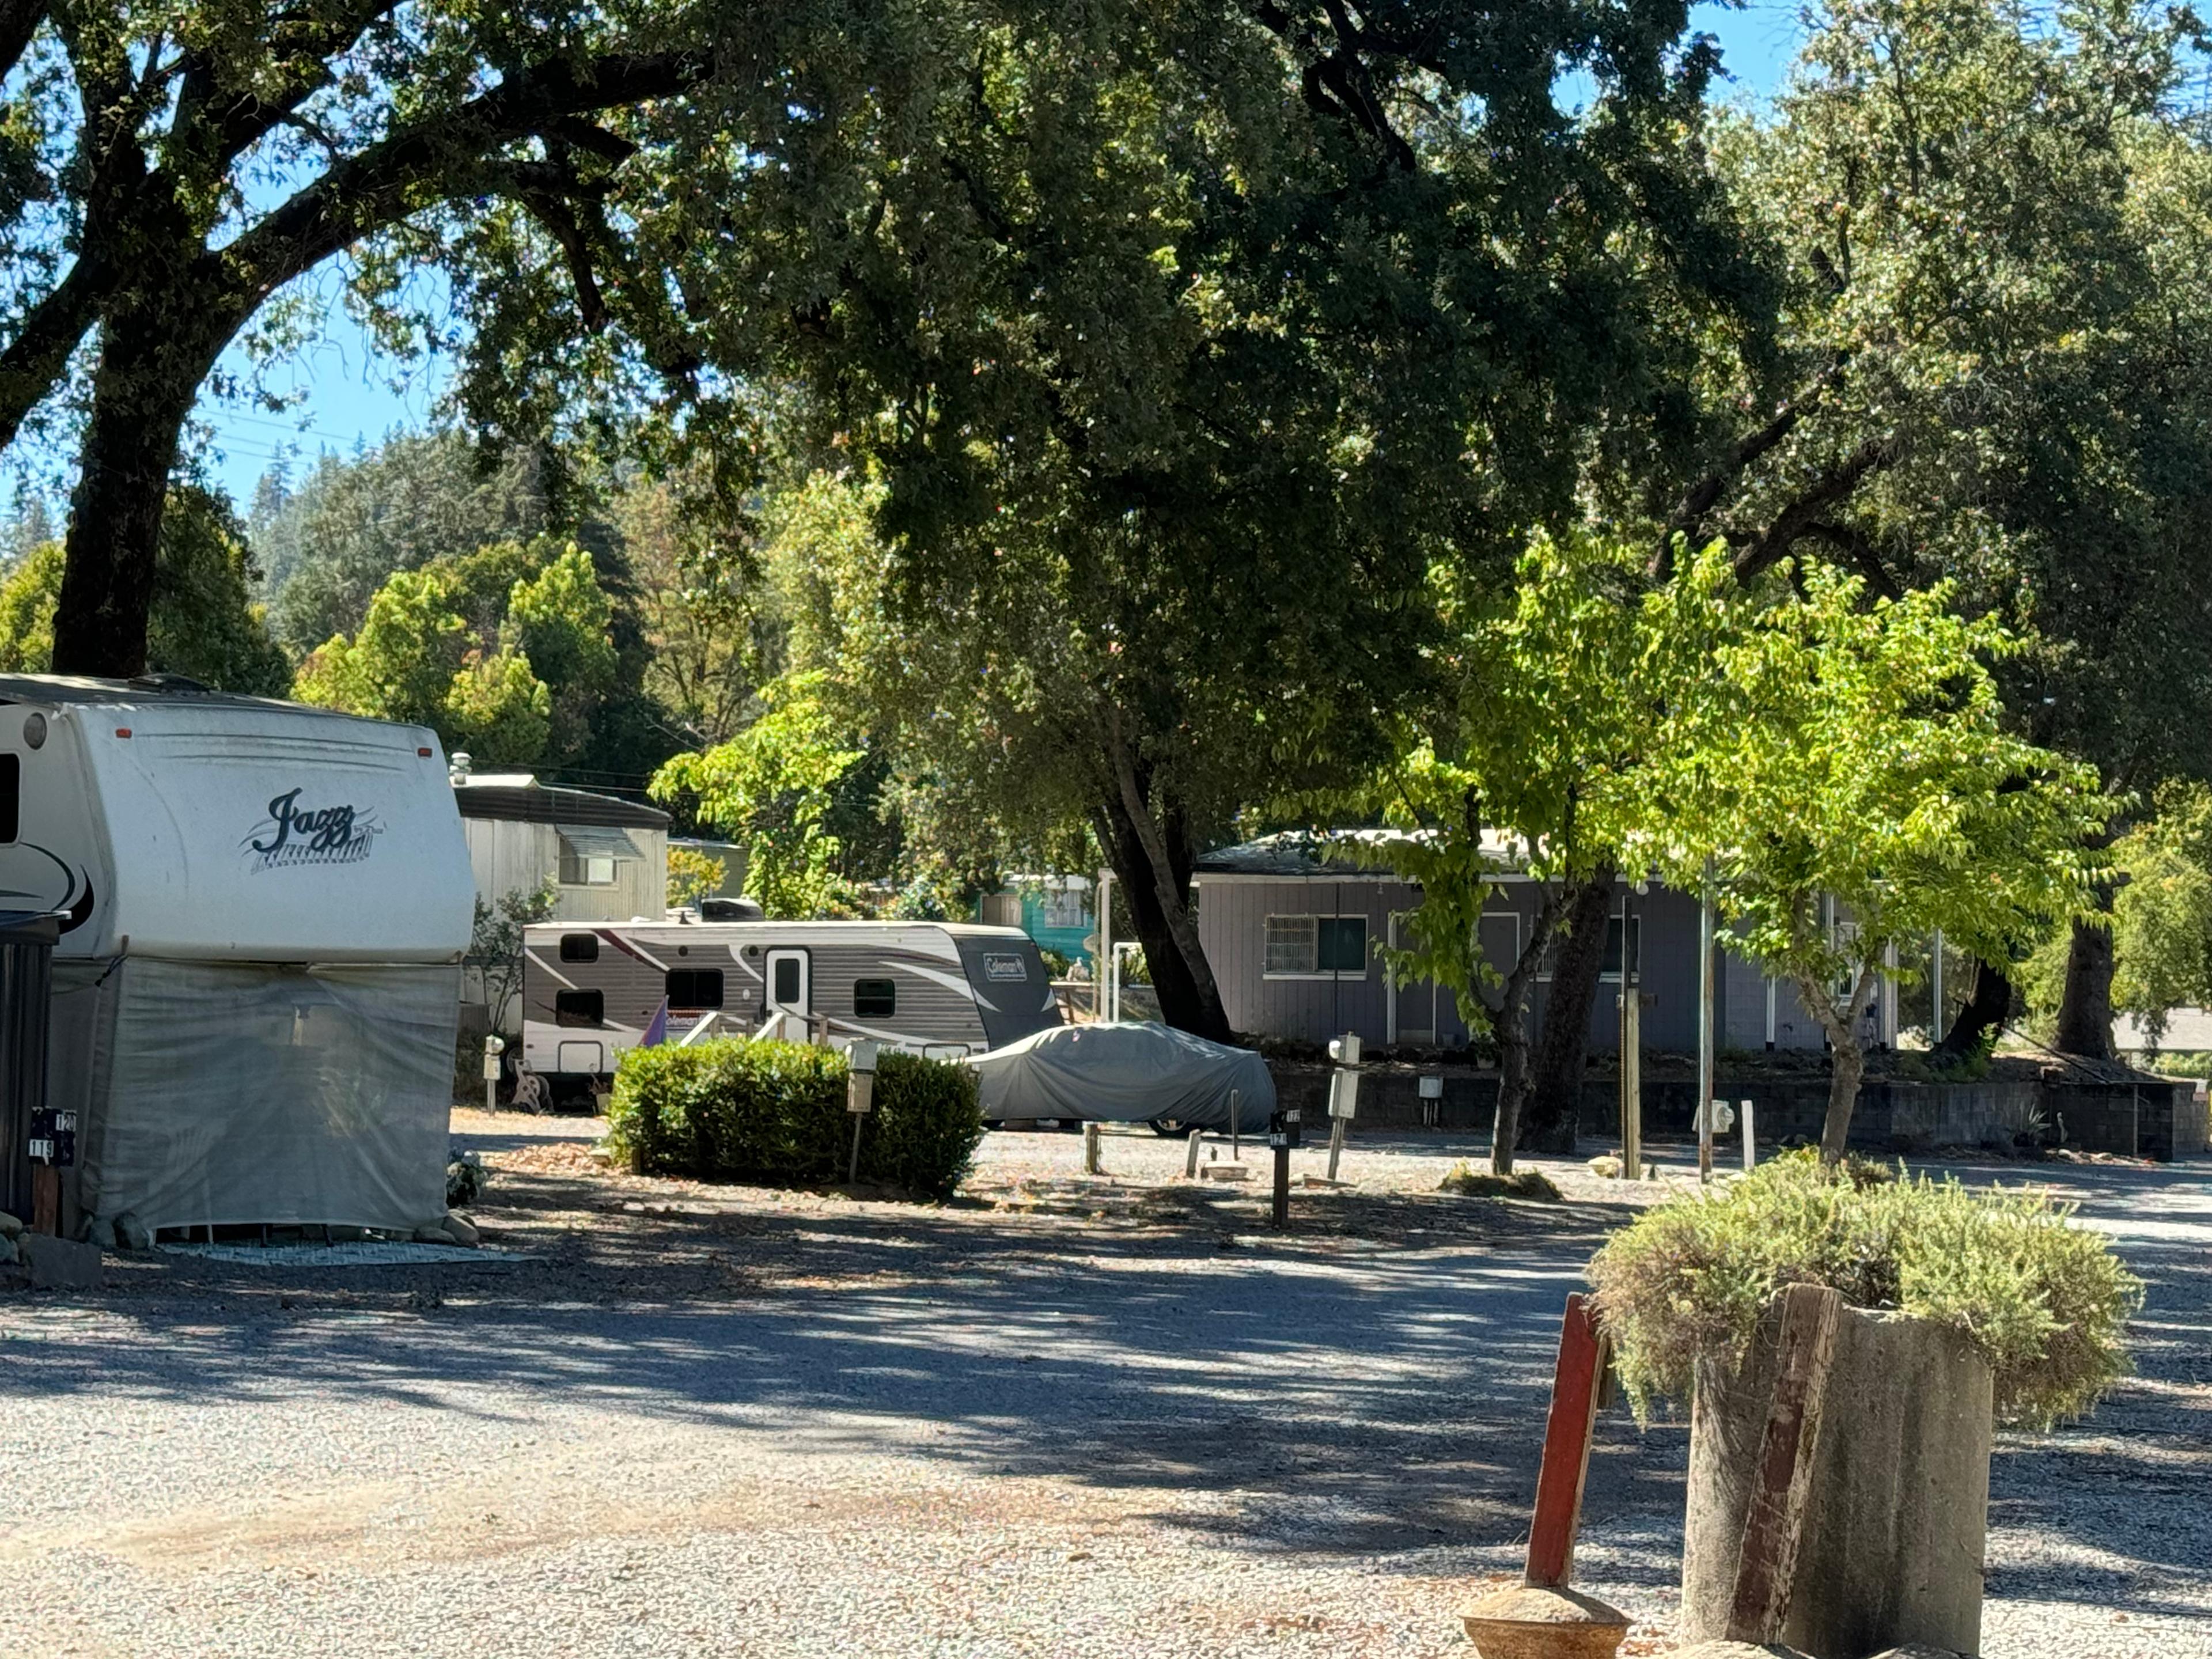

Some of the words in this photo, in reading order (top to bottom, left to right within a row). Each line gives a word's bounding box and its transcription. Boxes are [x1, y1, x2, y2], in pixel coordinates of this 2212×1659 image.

[252, 787, 355, 853] Jazz
[986, 957, 1017, 974] Coleman
[665, 1014, 699, 1026] oleman
[58, 1113, 75, 1131] 120
[31, 1140, 53, 1156] 119
